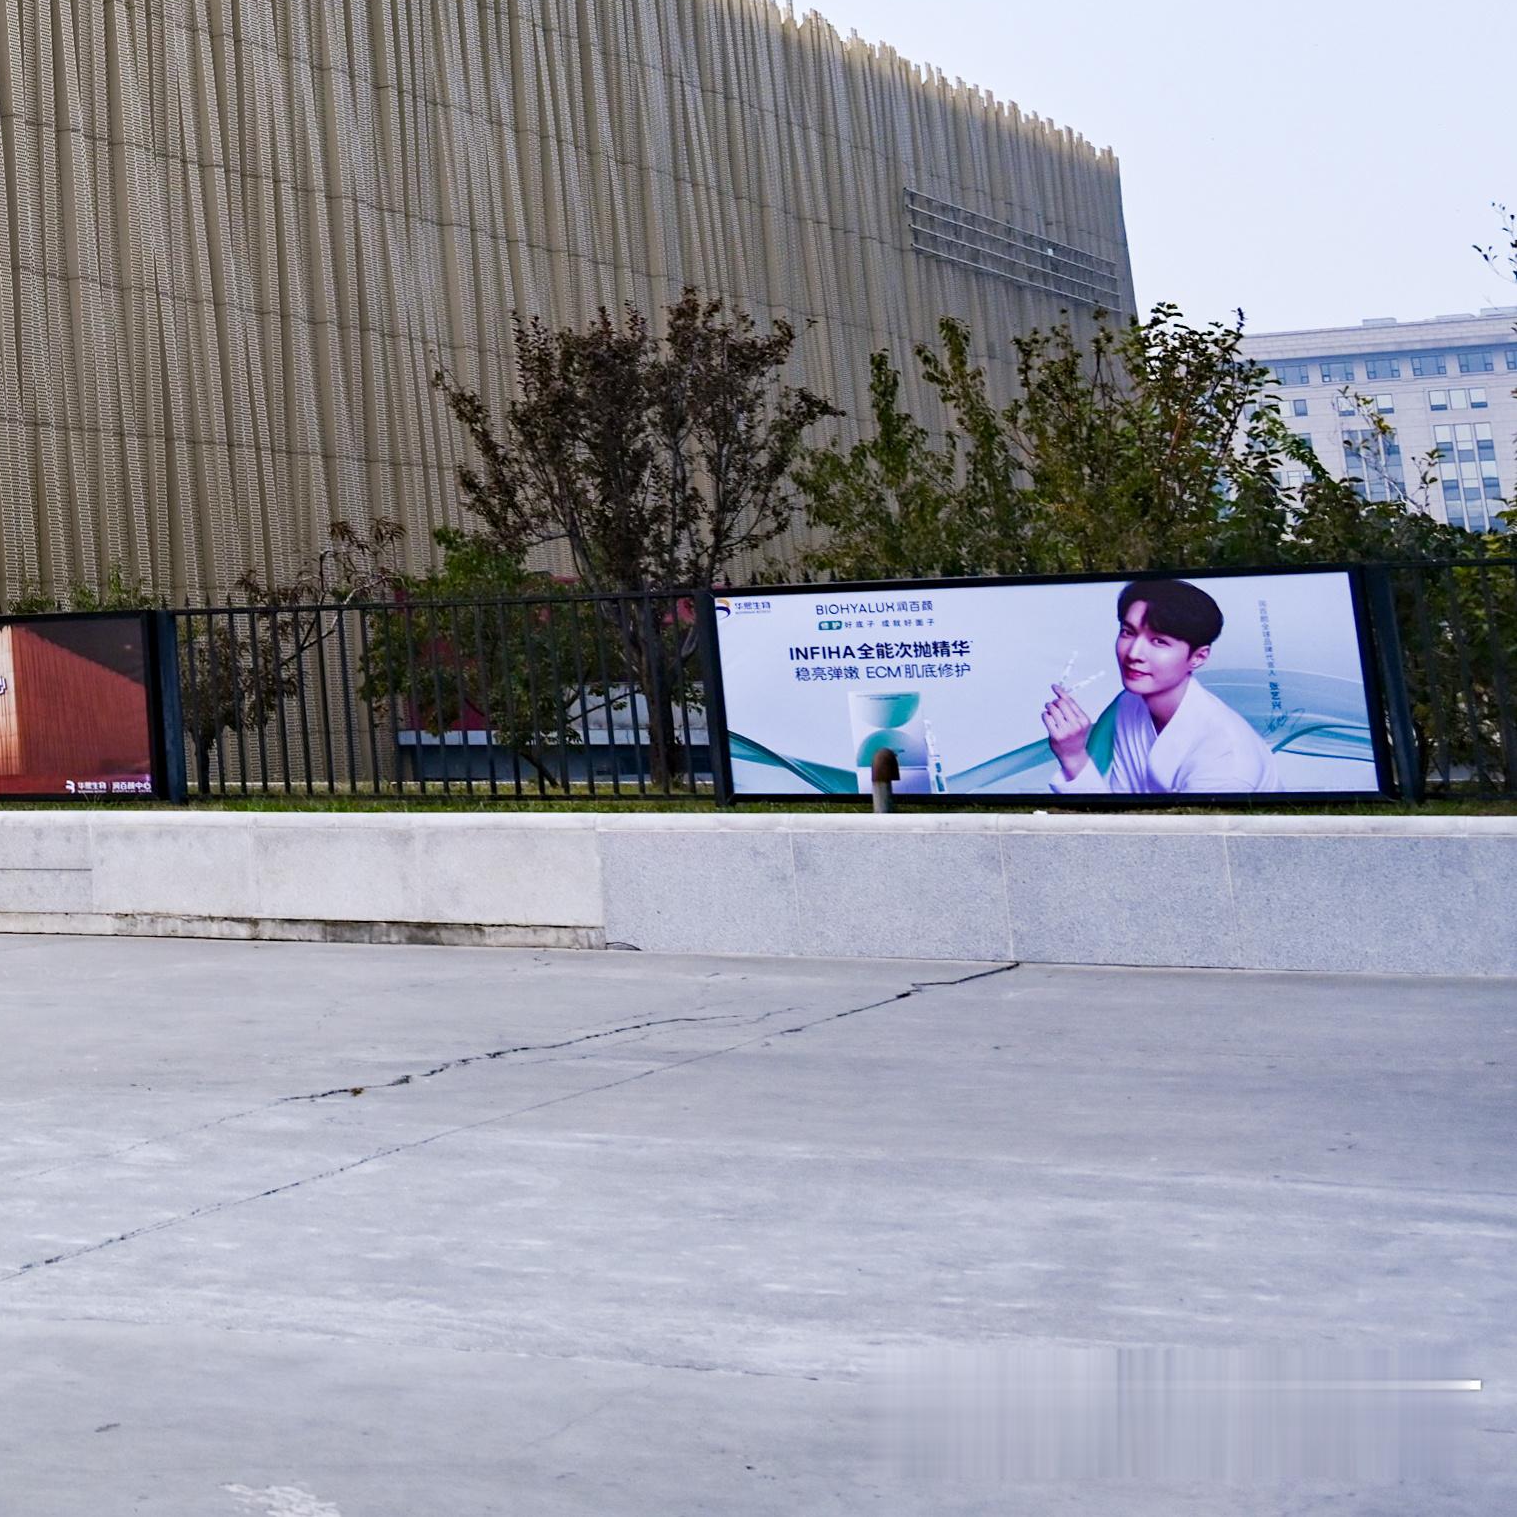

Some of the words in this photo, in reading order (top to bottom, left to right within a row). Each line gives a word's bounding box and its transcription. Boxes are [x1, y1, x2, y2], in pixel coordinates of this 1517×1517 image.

[790, 639, 971, 661] INFIHA全能次抛精华
